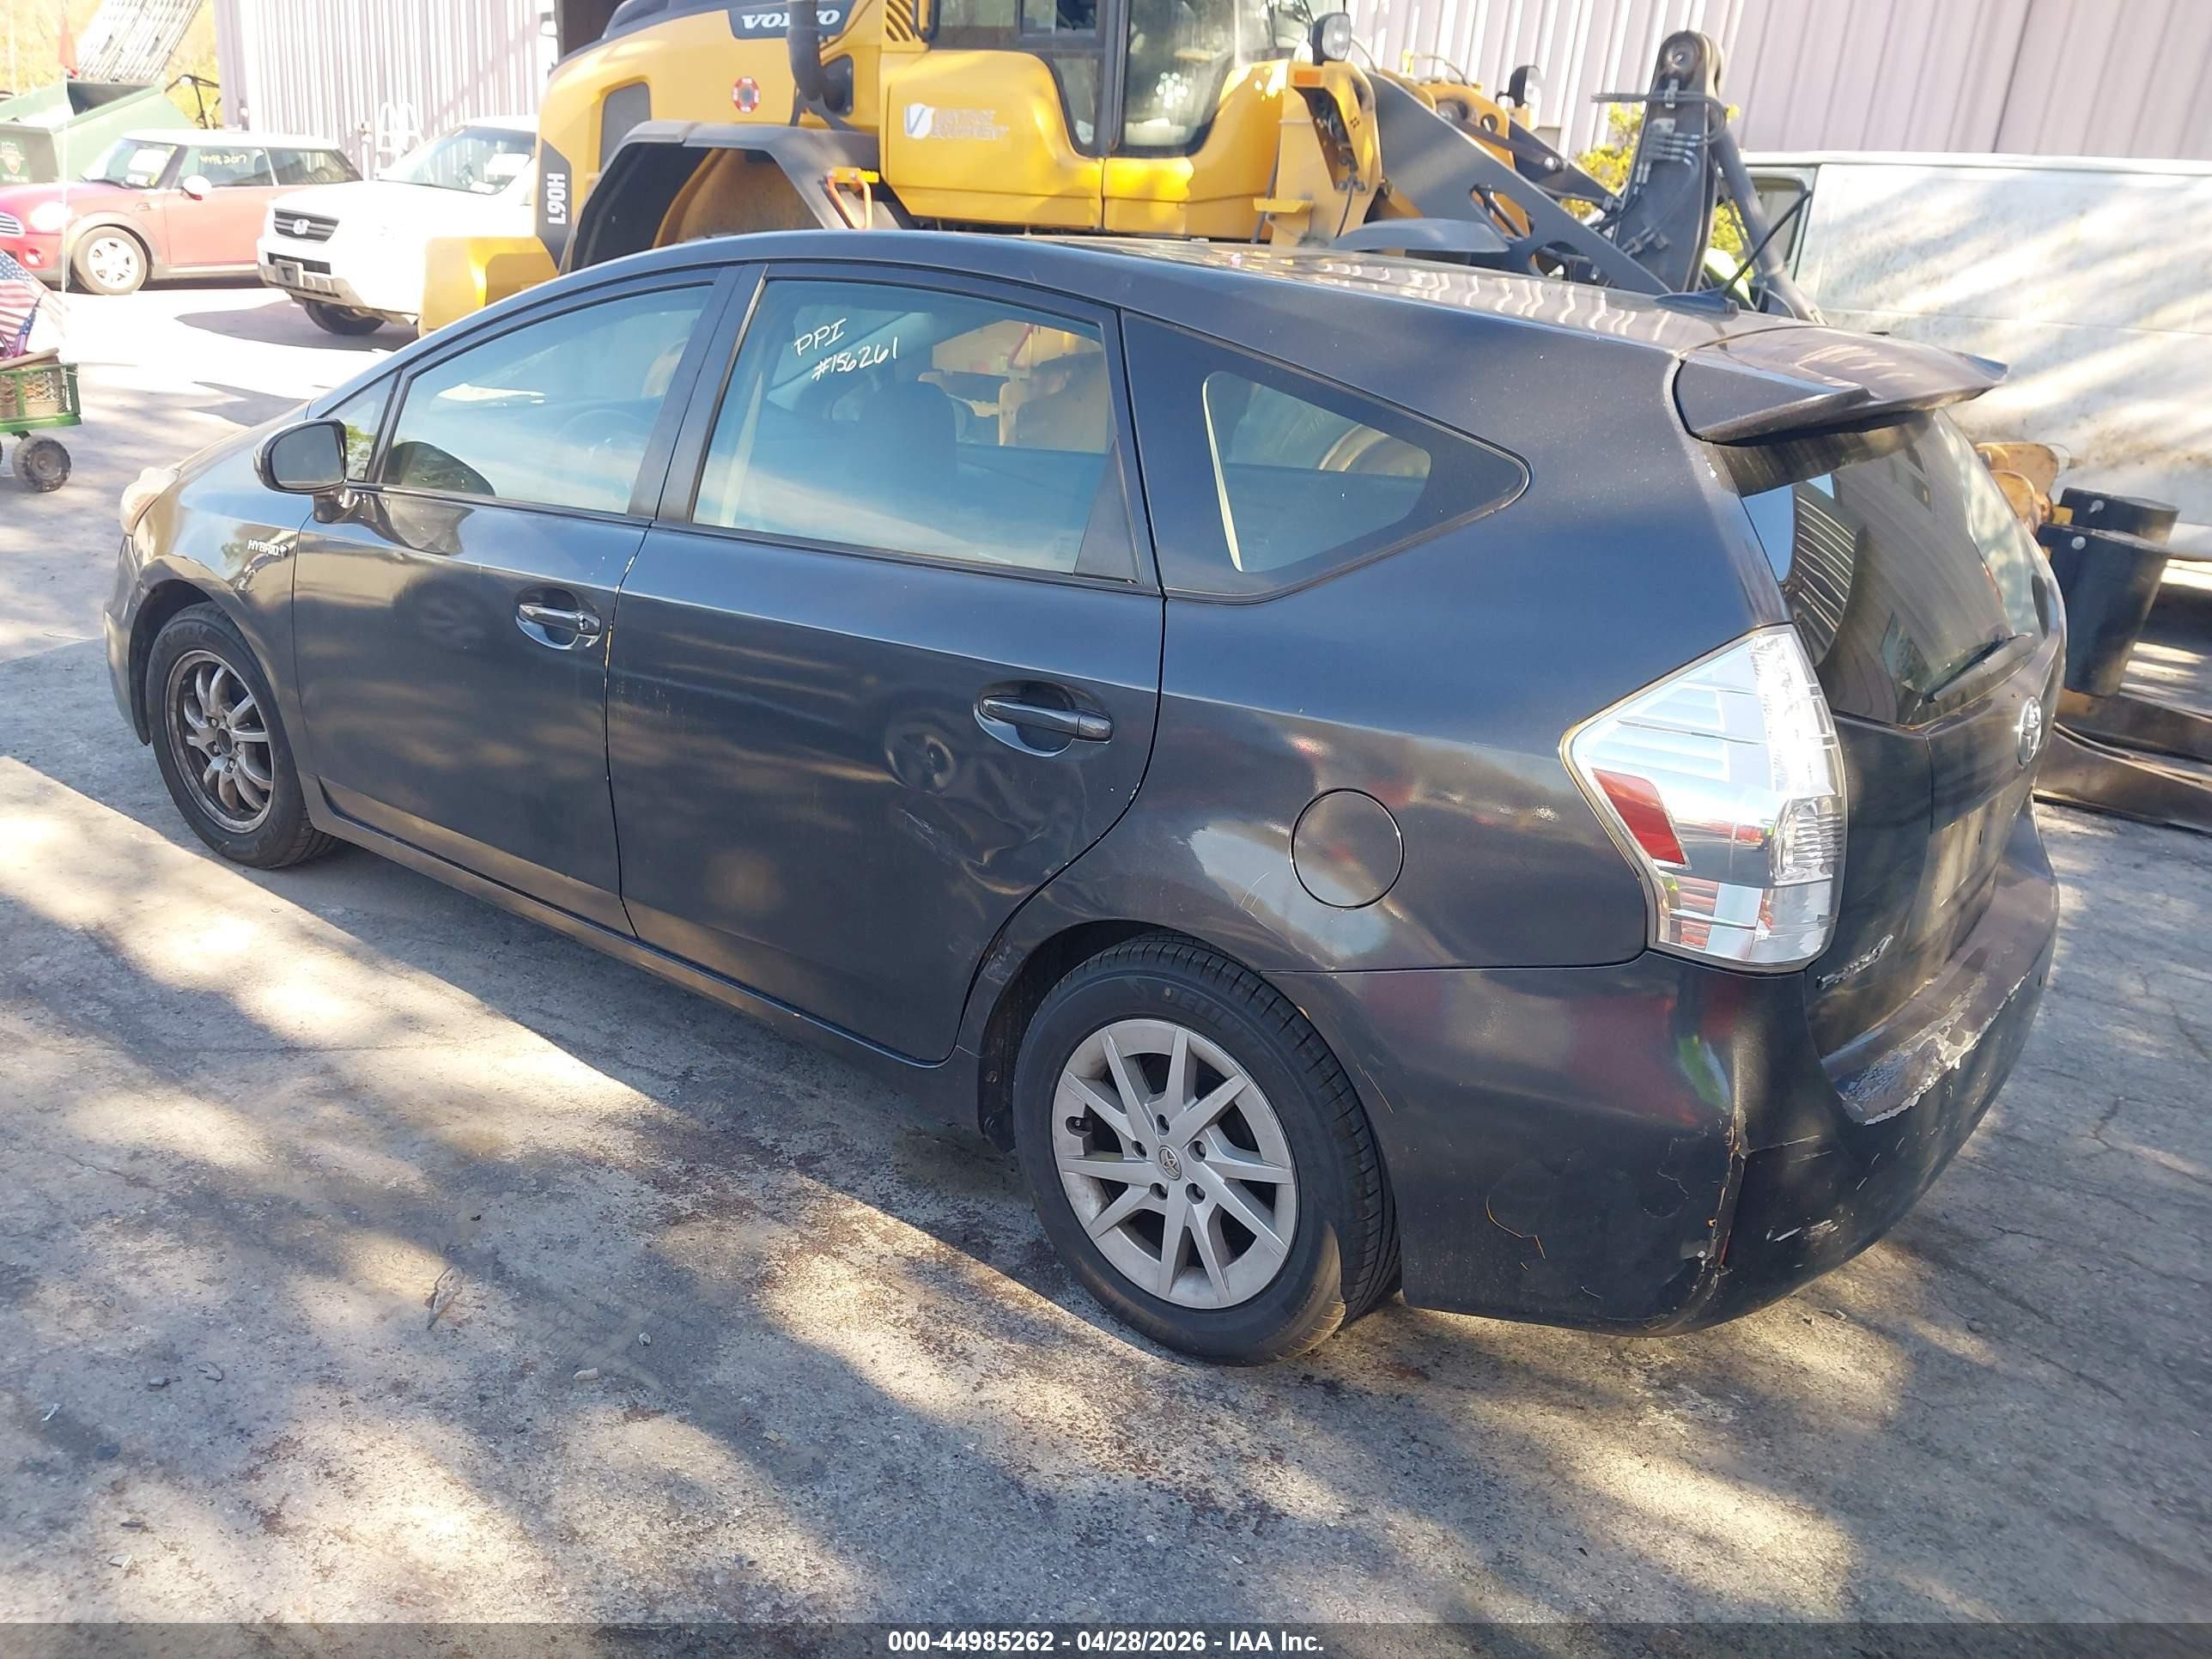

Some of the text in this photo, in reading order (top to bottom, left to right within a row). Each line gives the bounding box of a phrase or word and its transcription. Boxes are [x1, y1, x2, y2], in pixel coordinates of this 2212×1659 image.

[742, 9, 841, 29] VOLO
[546, 173, 567, 225] L90H
[794, 318, 848, 356] PPI
[811, 337, 899, 381] #156261
